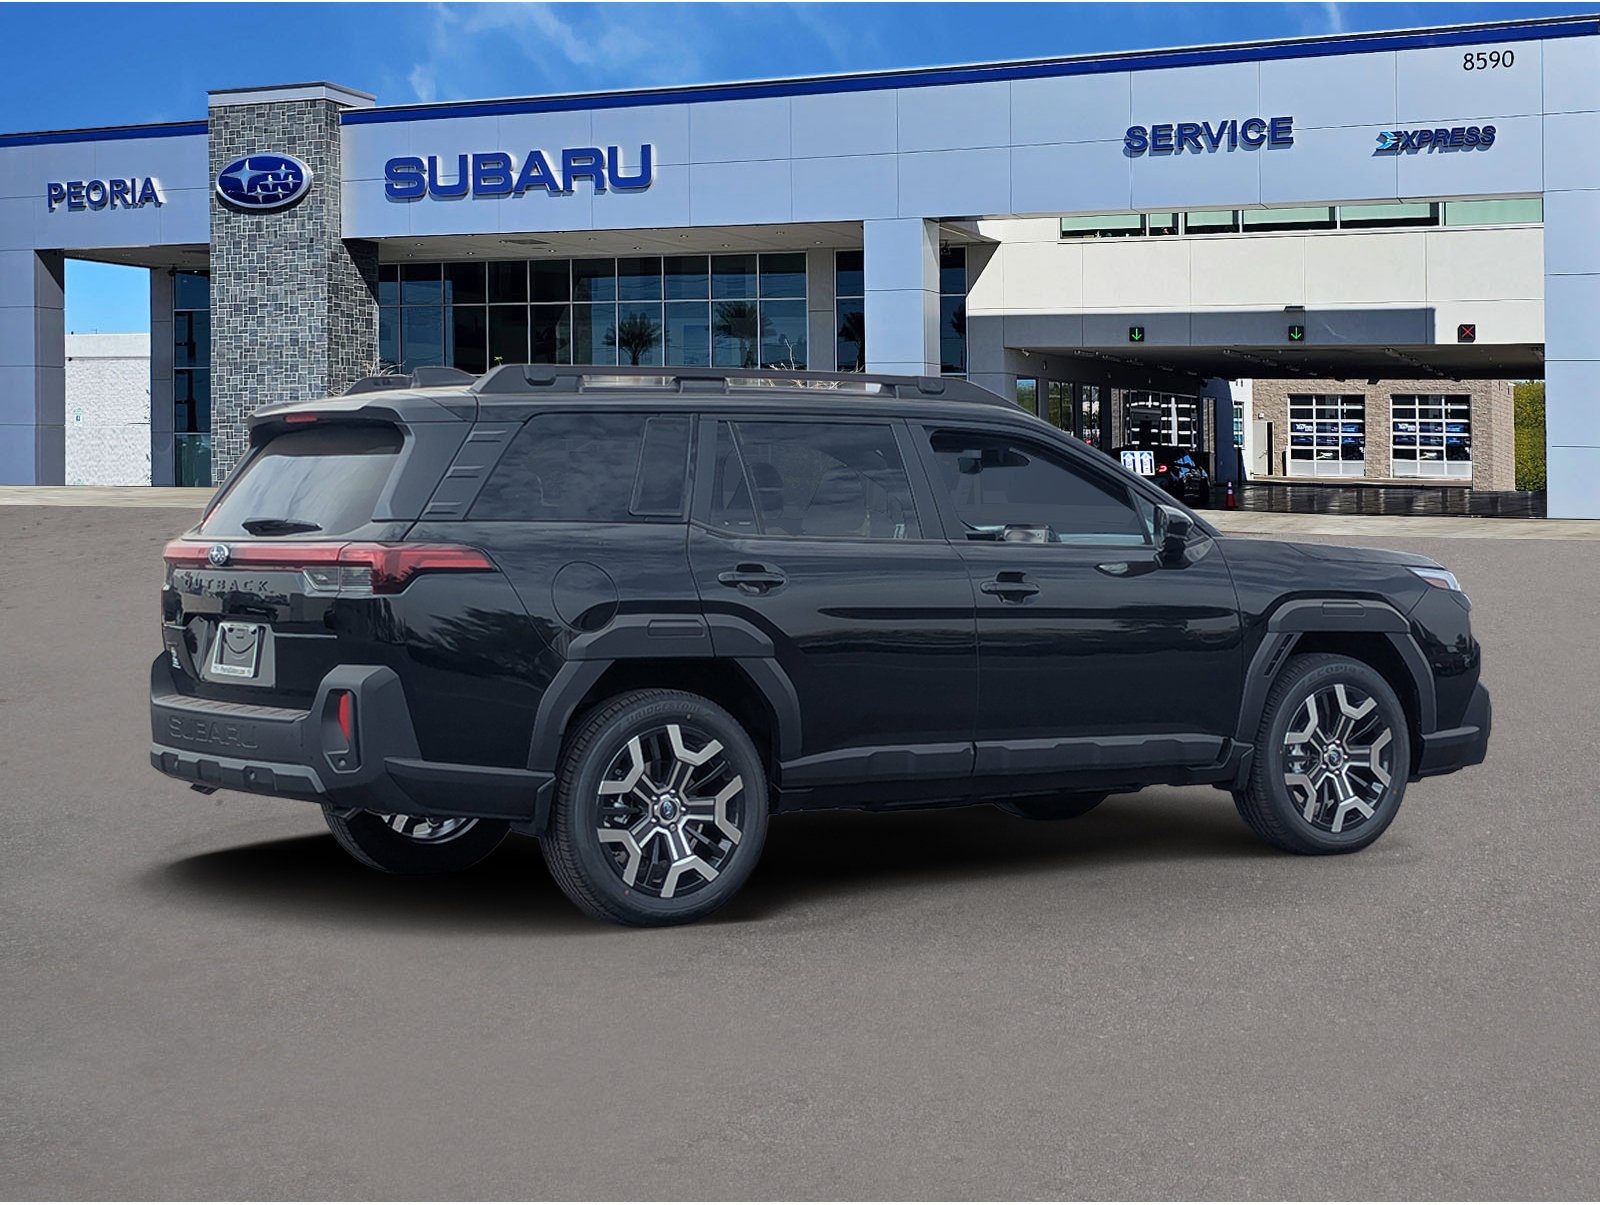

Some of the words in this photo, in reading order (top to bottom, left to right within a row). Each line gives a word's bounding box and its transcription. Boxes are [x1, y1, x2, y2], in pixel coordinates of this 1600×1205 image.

[1463, 50, 1515, 71] 8590
[1125, 116, 1295, 152] SERVICE
[1376, 125, 1497, 151] EXPRESS
[384, 144, 652, 200] SUBARU
[47, 177, 163, 211] PEORIA
[167, 715, 259, 750] SUBARU
